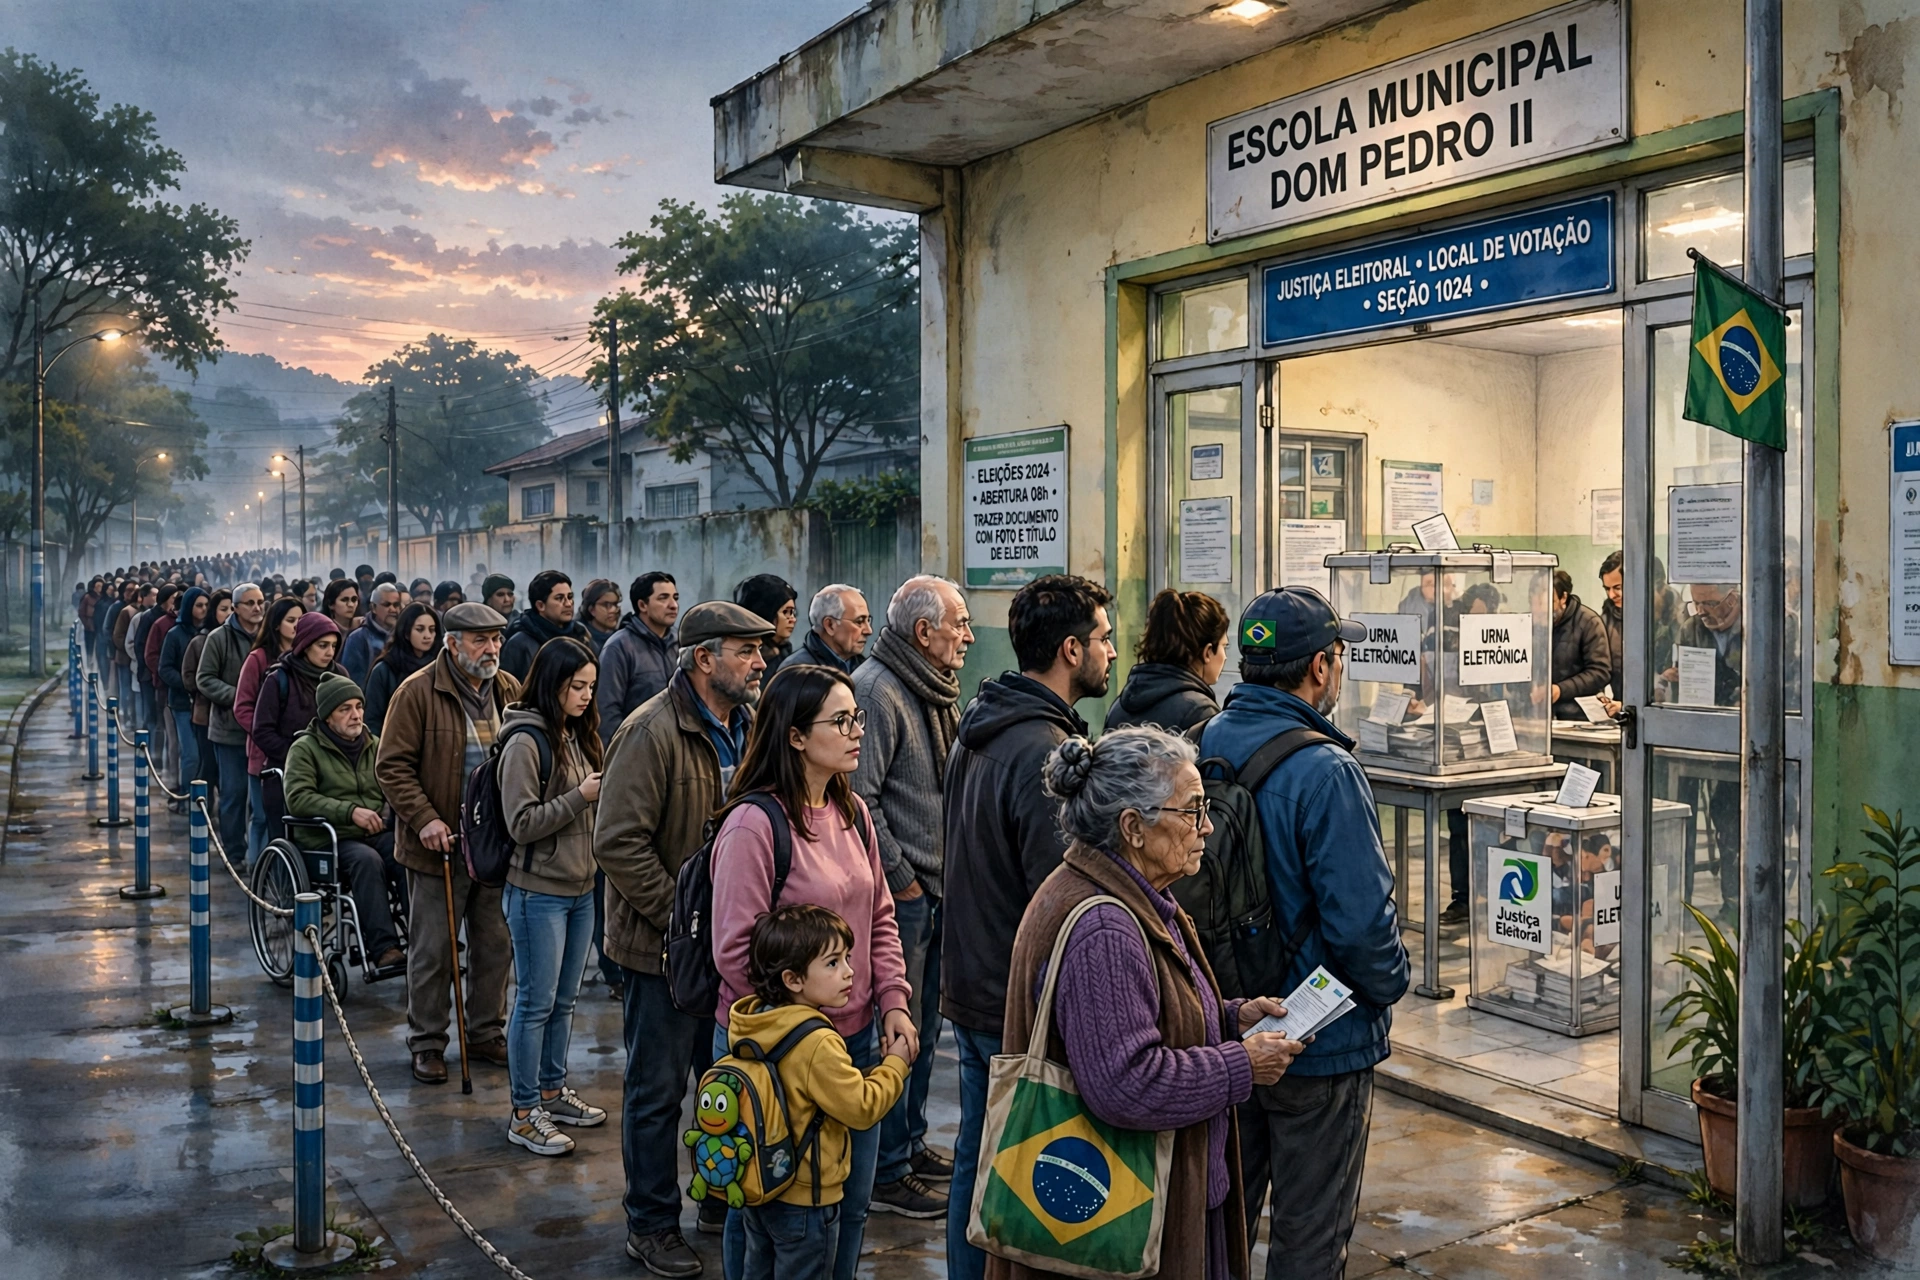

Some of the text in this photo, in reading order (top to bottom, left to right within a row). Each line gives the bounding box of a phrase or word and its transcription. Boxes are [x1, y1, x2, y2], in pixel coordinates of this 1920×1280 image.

[1228, 23, 1593, 170] ESCOLA MUNICIPAL
[1271, 98, 1533, 210] DOM PEDRO II
[1277, 216, 1591, 300] JUSTIÇA ELEITORAL LOCAL DE VOTAÇÃO
[1377, 275, 1473, 315] SEÇÃO 1024
[978, 463, 1050, 486] ELEIÇÕES 2024
[980, 486, 1048, 505] ABERTURA 08h
[974, 509, 1058, 527] TRAZER DOCUMENTO
[976, 525, 1056, 544] COM FOTO E TÍTULO
[991, 546, 1039, 560] DE ELEITOR
[1369, 628, 1398, 643] URNA
[1482, 628, 1510, 643] URNA
[1497, 906, 1540, 929] Justiça
[1496, 921, 1541, 943] Eleitoral
